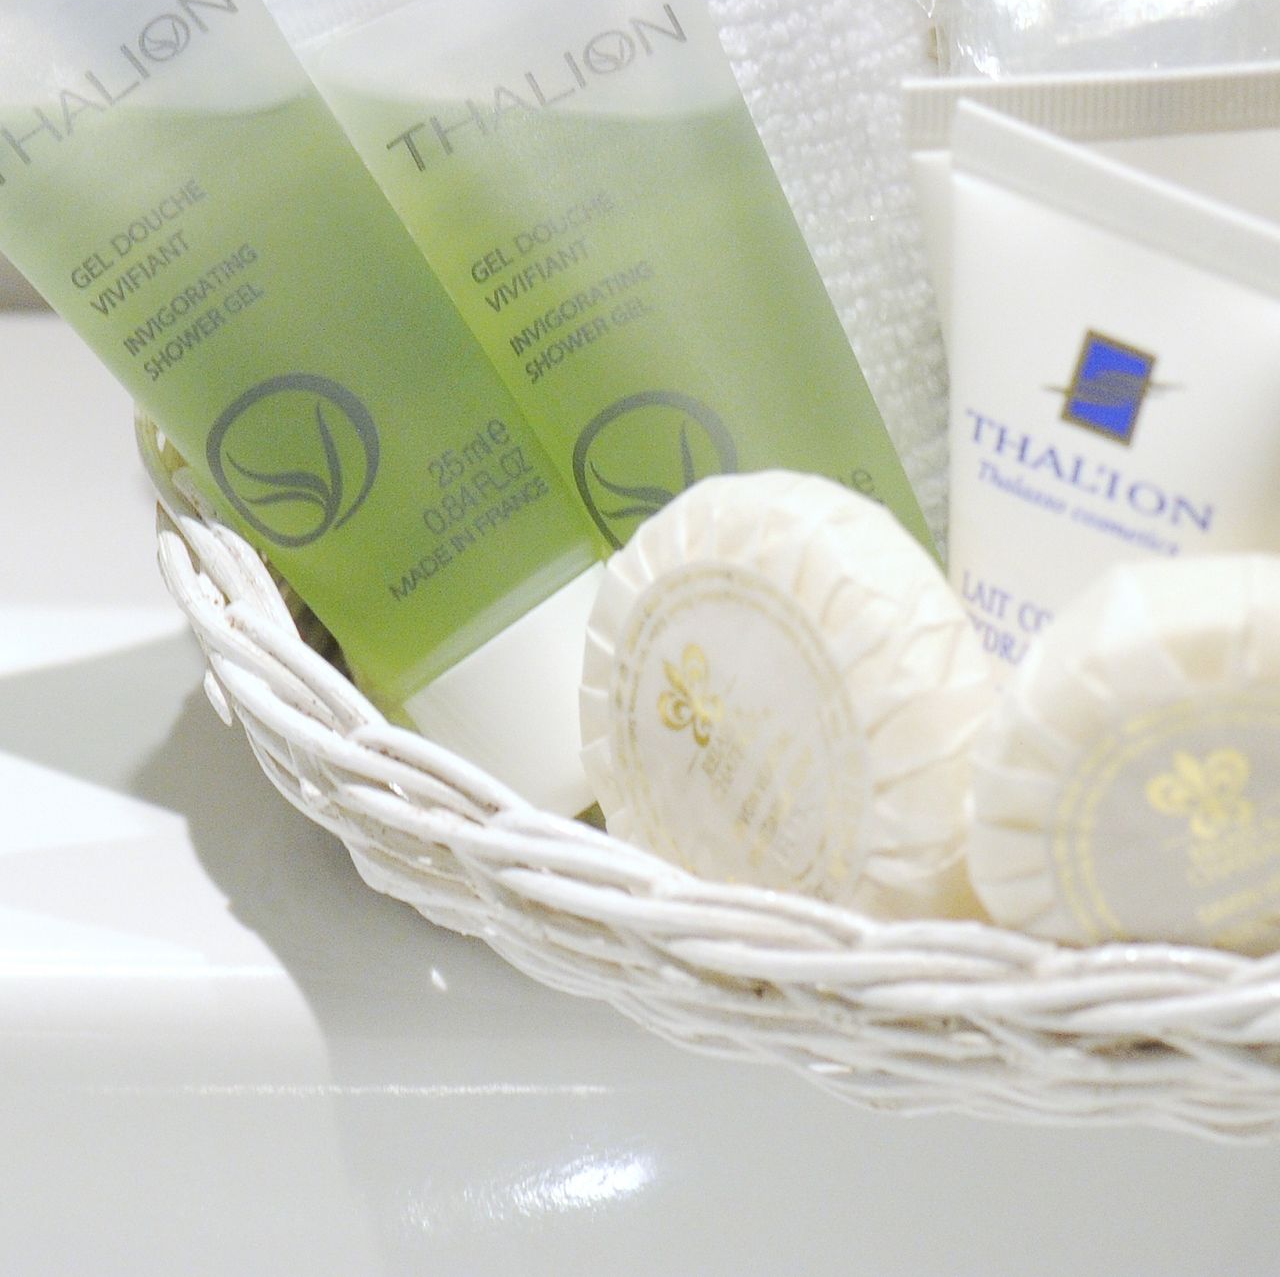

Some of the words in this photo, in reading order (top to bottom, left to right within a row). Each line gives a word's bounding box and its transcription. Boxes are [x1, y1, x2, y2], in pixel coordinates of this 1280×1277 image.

[386, 2, 687, 172] THALION
[71, 252, 115, 289] GEL
[110, 179, 208, 257] DOUCHE
[89, 228, 190, 316] VIVIFIANT
[471, 248, 514, 284] GEL
[485, 236, 591, 313] VIVIFIANT
[123, 243, 259, 357] INVIGORATING
[143, 308, 226, 382] SHOWER
[222, 283, 265, 315] GEL
[509, 260, 654, 358] INVIGORATING
[525, 316, 610, 385] SHOWER
[965, 407, 1215, 535] THALION
[389, 544, 453, 602] MADE
[961, 569, 1016, 621] LAIT
